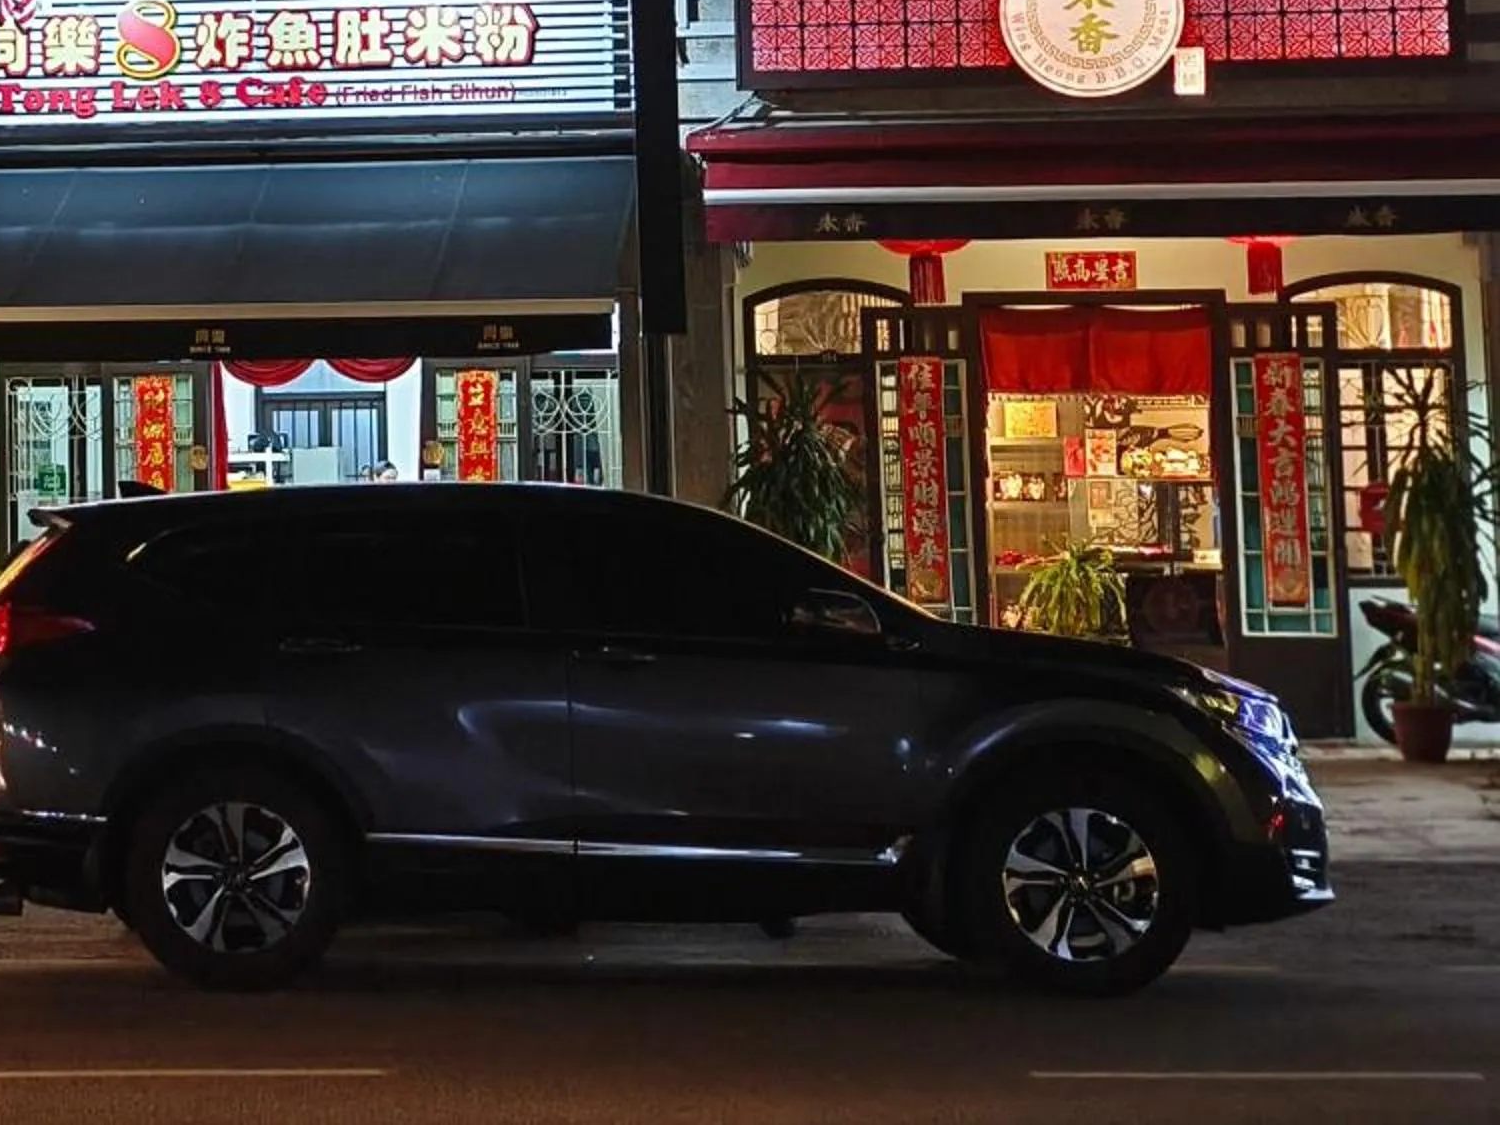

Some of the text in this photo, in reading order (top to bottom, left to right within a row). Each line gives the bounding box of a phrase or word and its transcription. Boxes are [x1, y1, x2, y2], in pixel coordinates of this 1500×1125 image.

[110, 81, 186, 112] Lek
[199, 80, 225, 108] 8
[236, 76, 328, 106] Cafe
